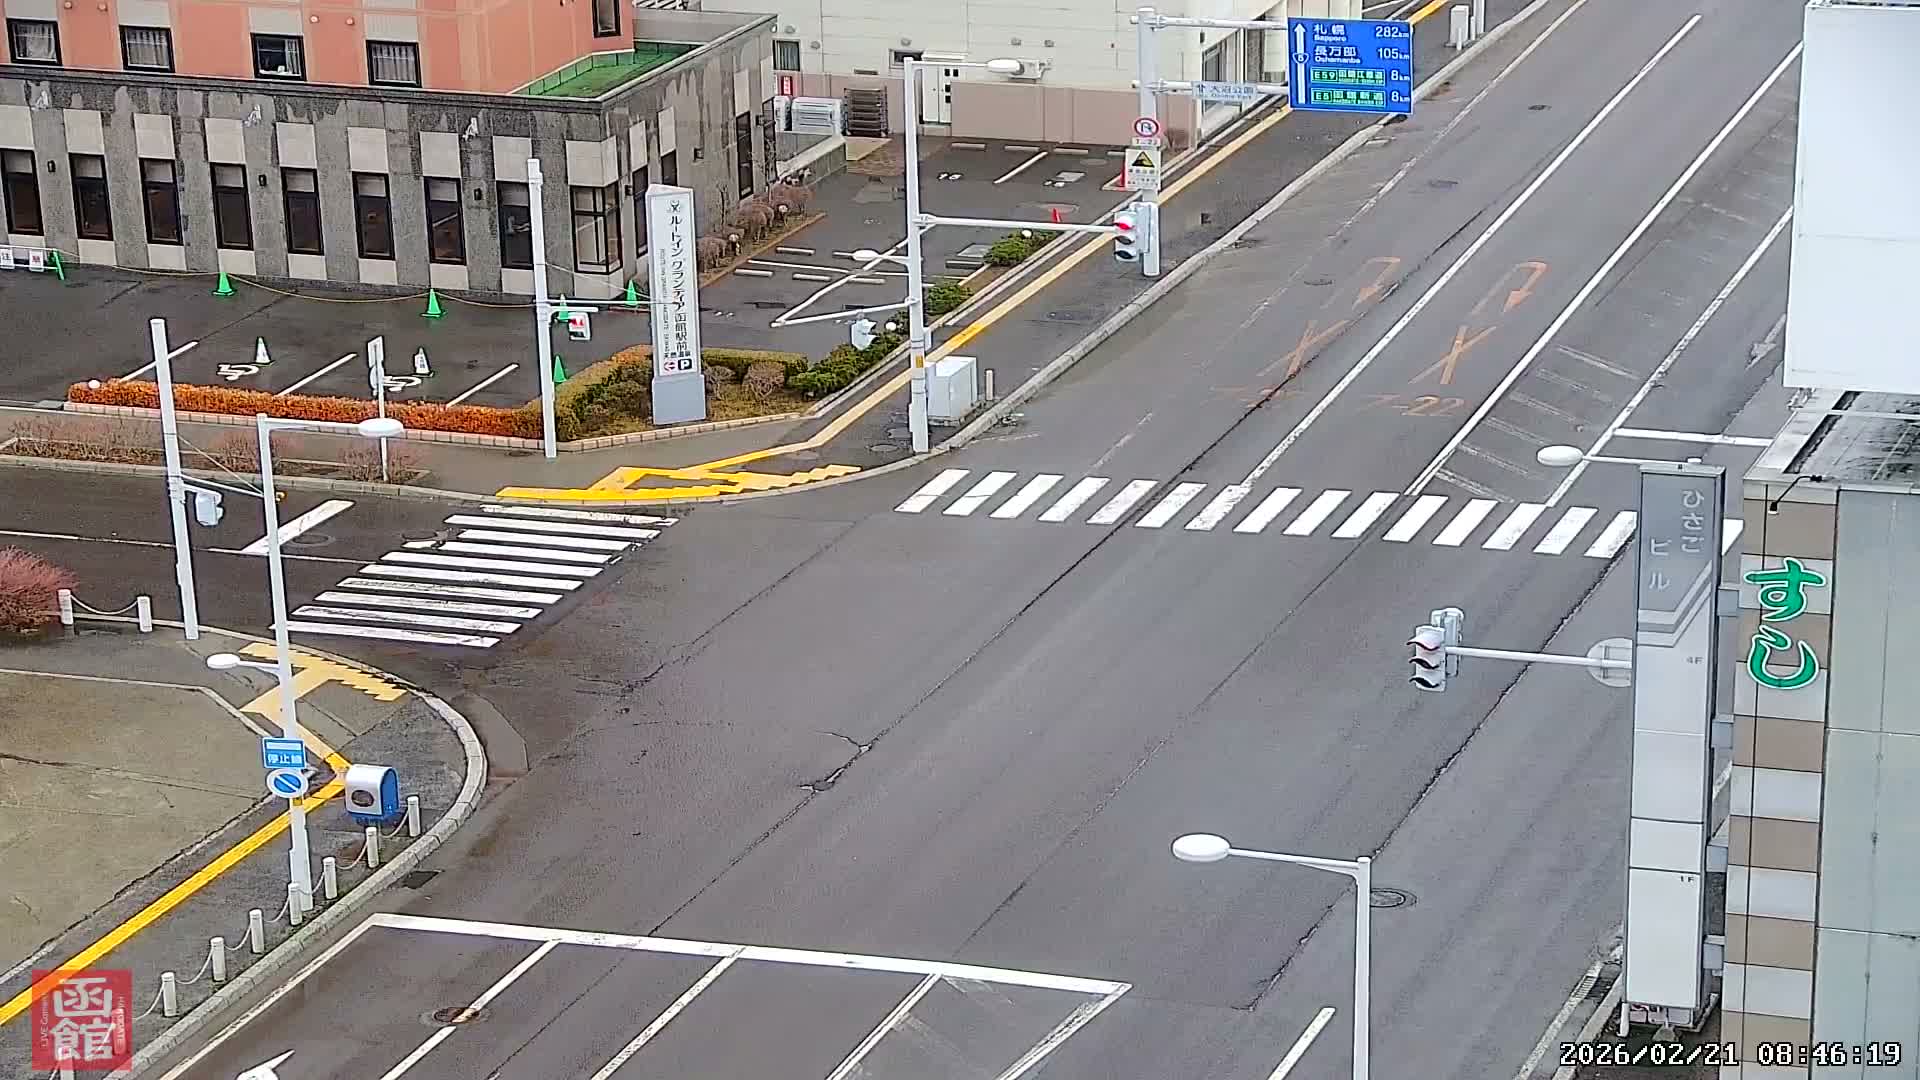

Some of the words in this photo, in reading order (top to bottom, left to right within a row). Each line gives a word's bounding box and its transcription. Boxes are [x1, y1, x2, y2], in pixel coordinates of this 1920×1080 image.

[1313, 24, 1345, 35] 札幌
[1315, 46, 1356, 57] 長万部
[1314, 71, 1336, 80] E59
